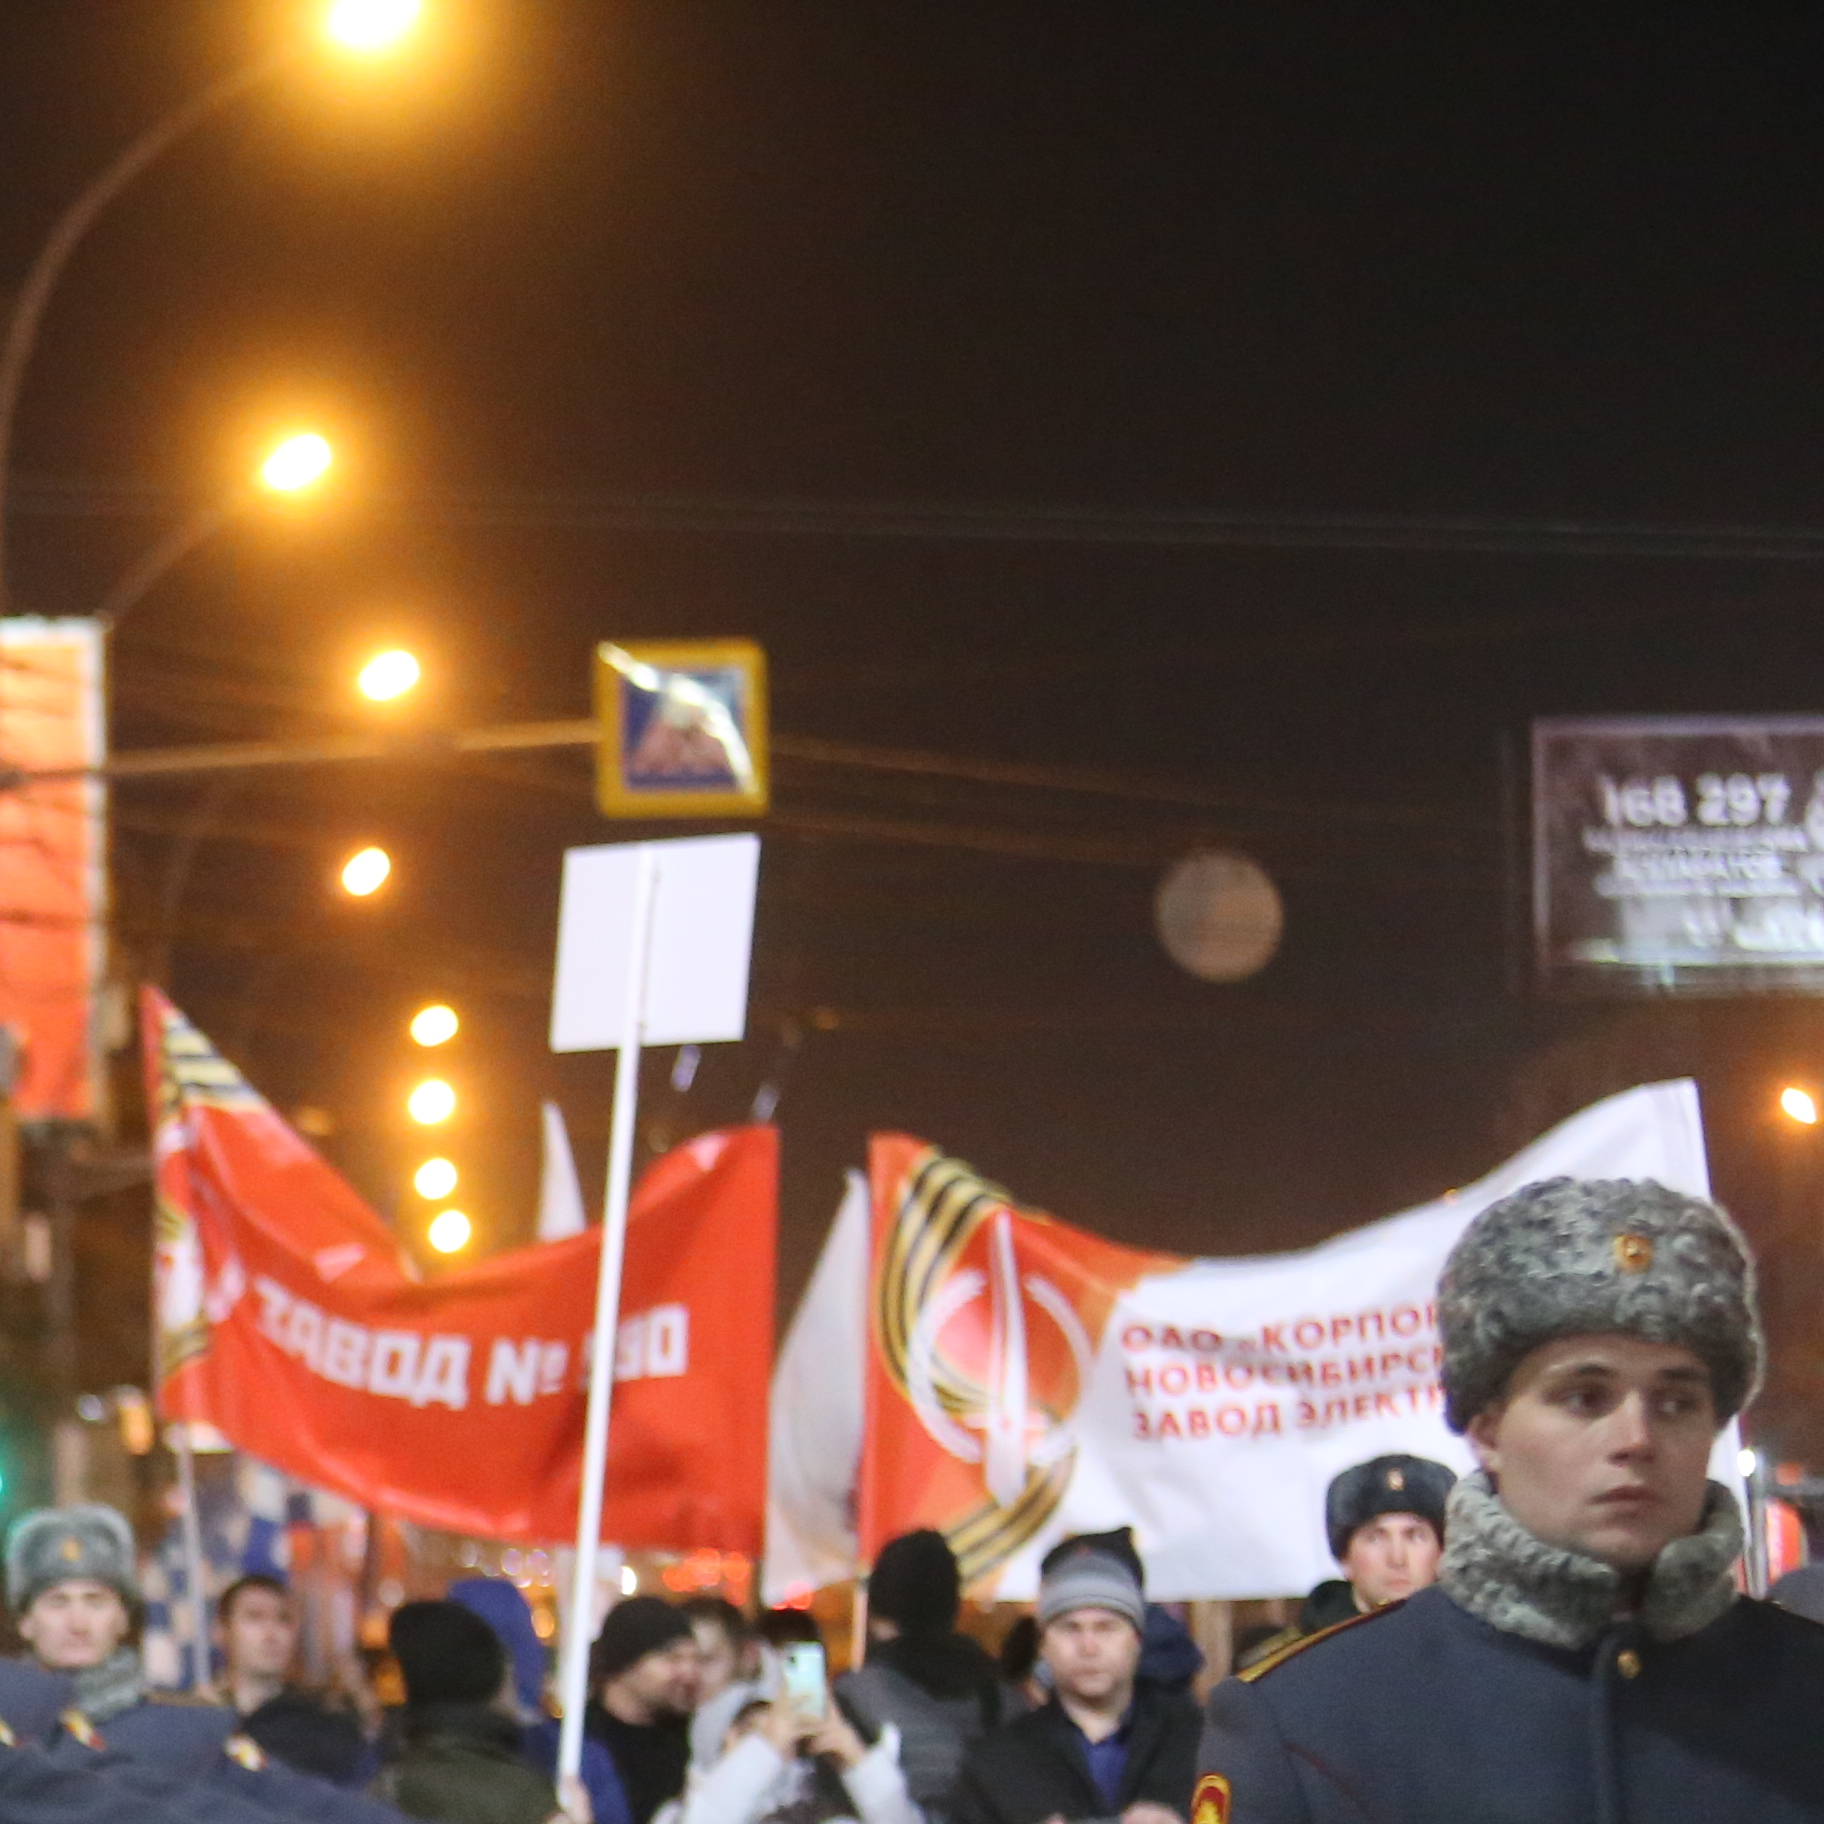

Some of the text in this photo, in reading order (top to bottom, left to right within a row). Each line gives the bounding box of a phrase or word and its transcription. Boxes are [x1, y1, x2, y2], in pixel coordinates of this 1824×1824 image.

[254, 1274, 470, 1410] ЗАВОД
[1121, 1323, 1223, 1352] ОАО
[1132, 1402, 1282, 1441] ЗАВОД
